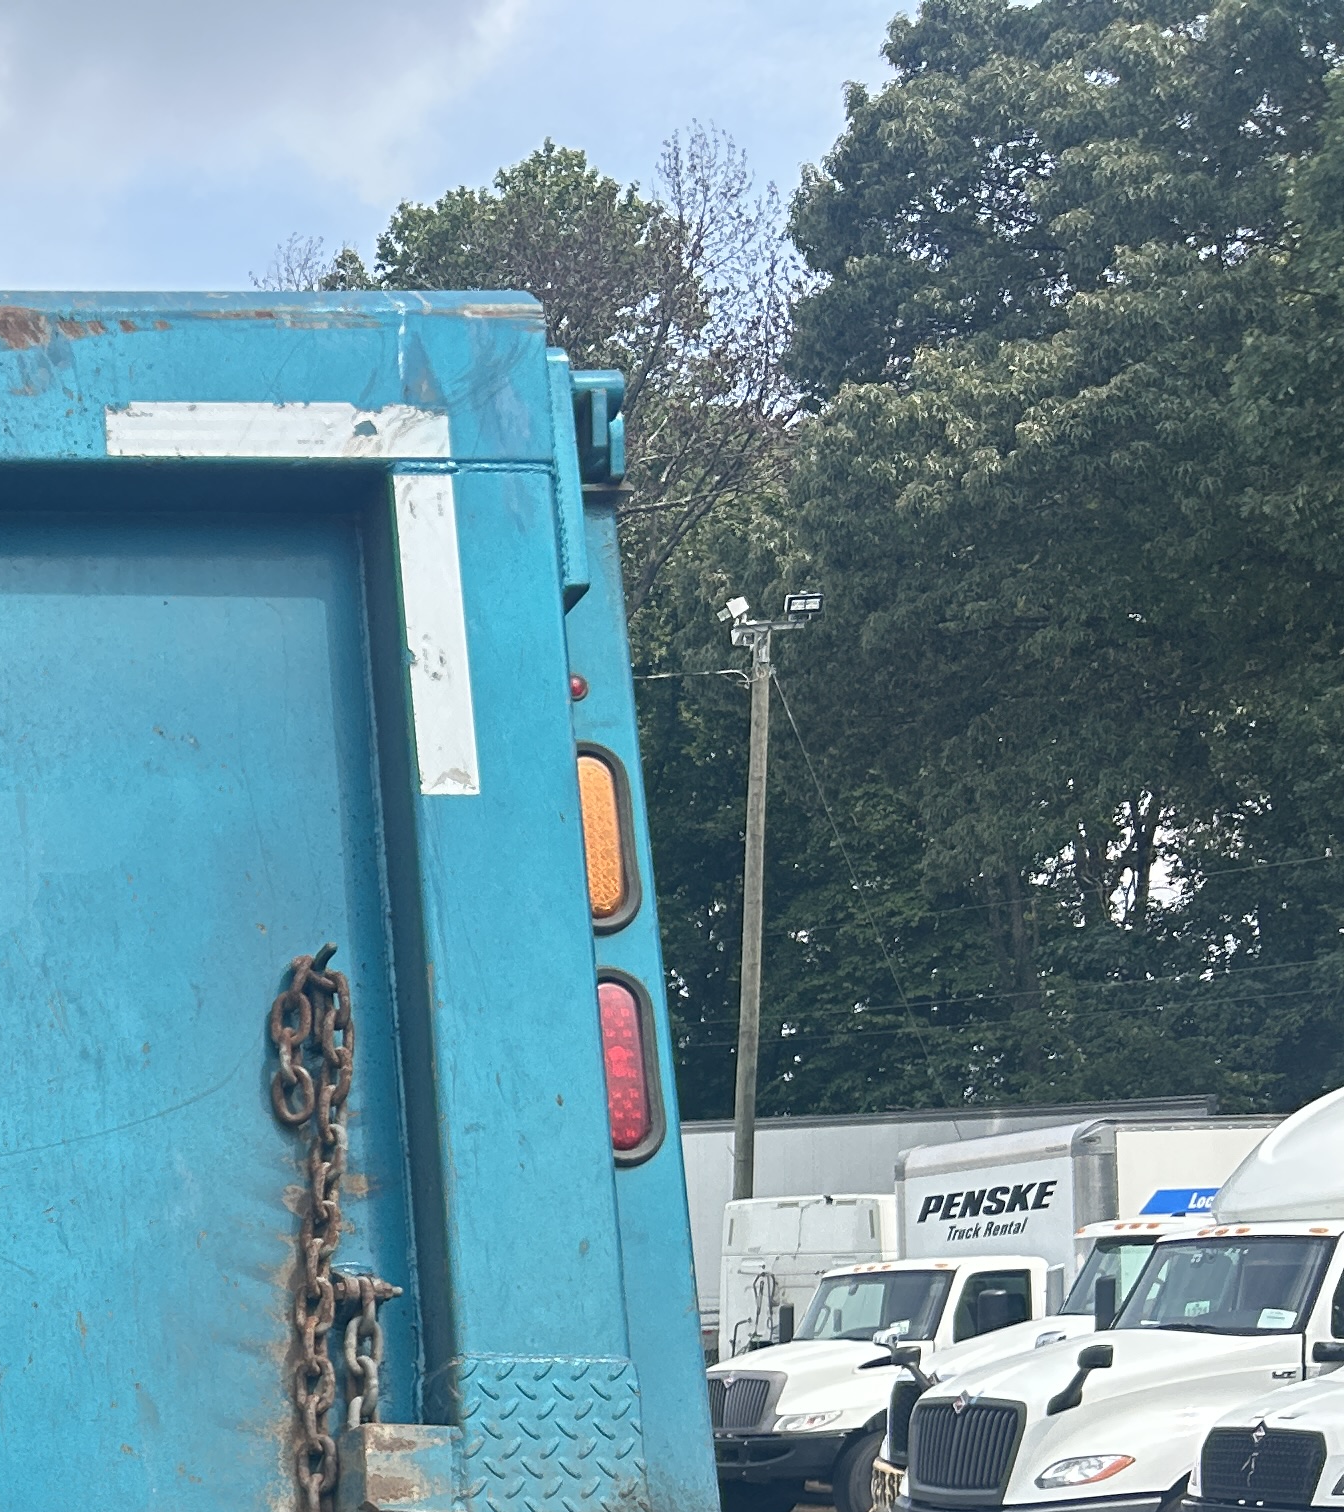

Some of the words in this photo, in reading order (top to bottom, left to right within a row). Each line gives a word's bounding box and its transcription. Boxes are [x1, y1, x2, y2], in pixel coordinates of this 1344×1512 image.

[916, 1180, 1058, 1224] PENSKE
[1187, 1191, 1214, 1210] Loc
[946, 1224, 981, 1242] Truck
[983, 1216, 1028, 1237] Rental
